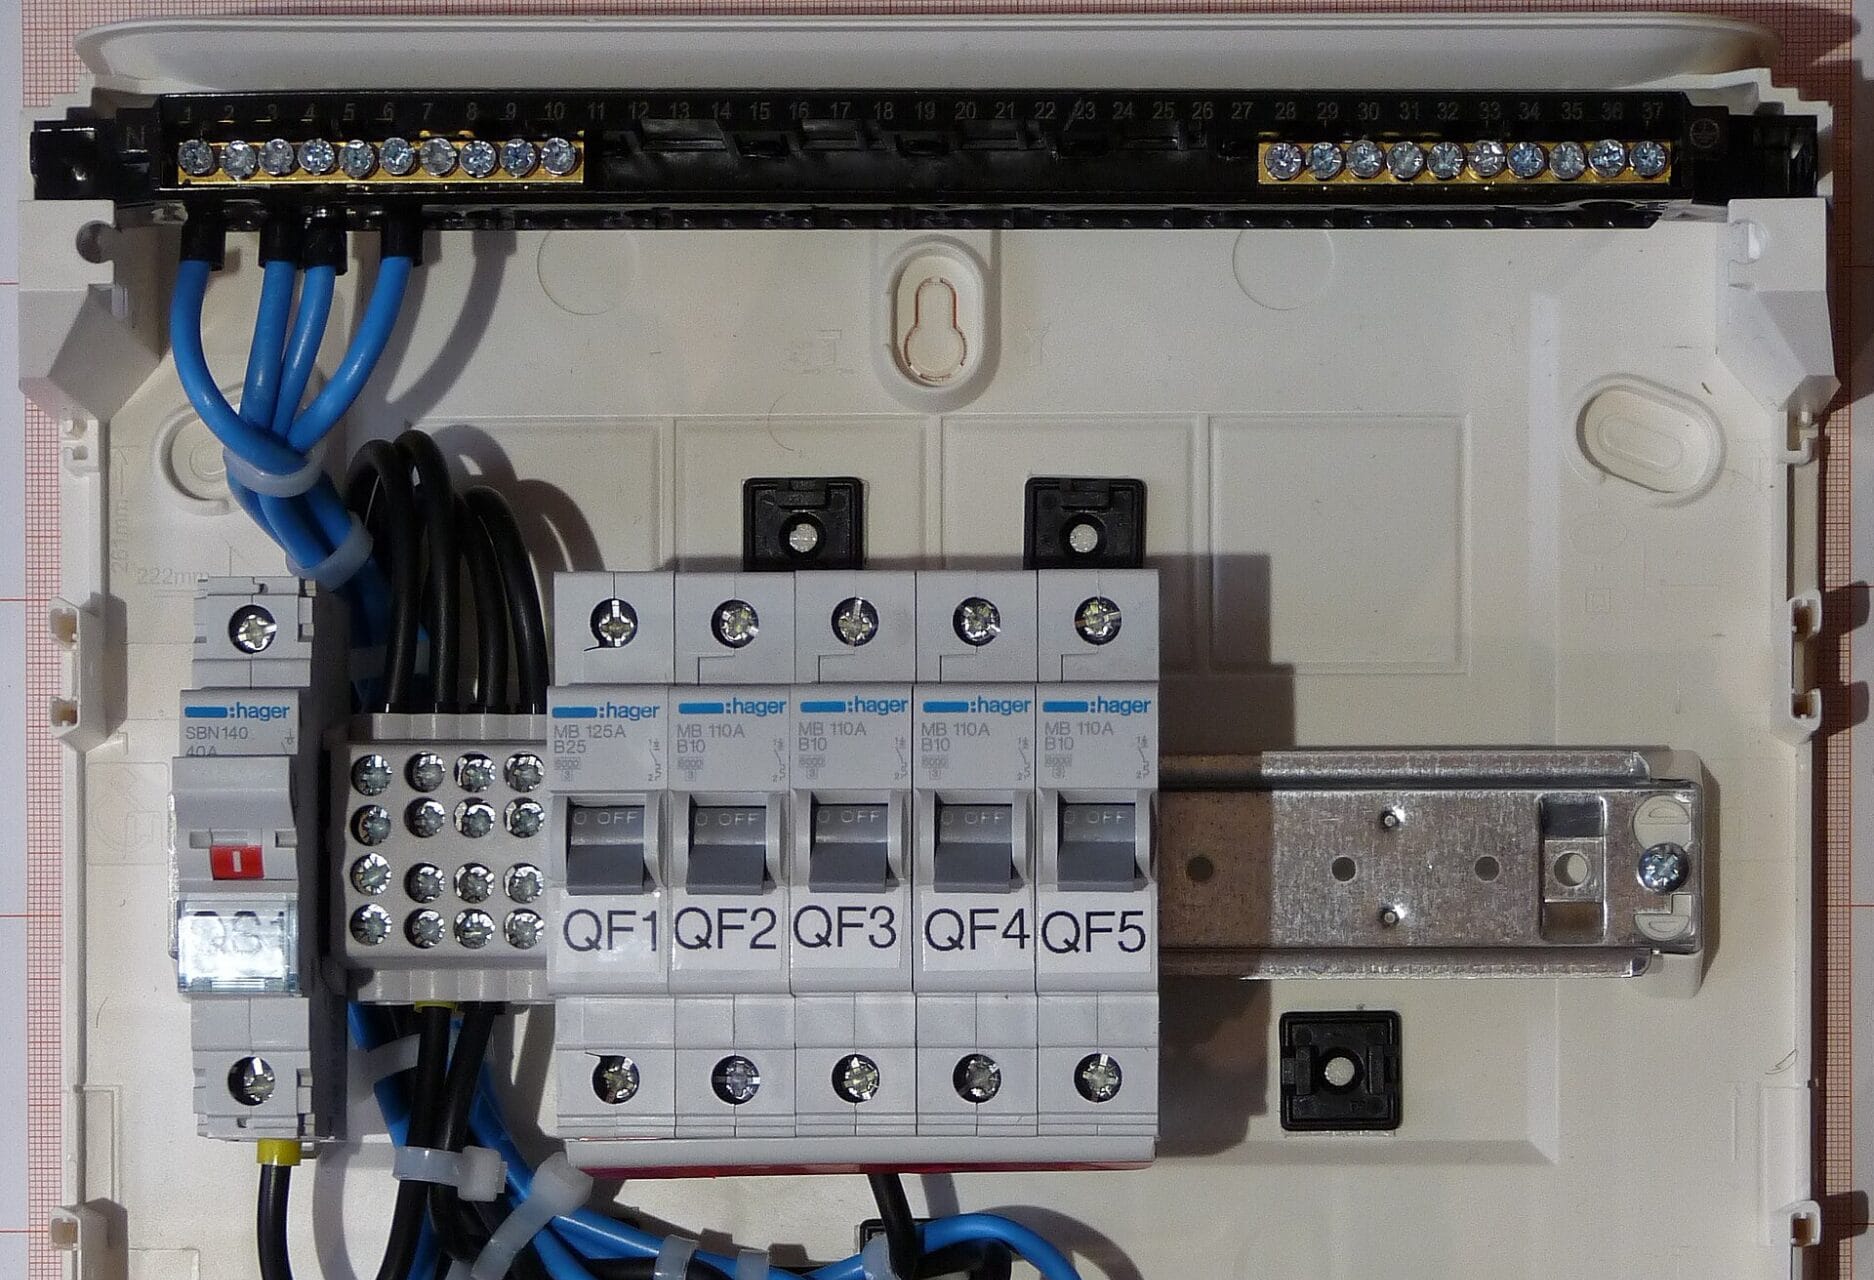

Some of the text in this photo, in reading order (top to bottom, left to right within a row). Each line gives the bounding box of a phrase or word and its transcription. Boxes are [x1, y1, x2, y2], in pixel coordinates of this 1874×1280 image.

[223, 102, 234, 119] 2
[305, 102, 316, 119] 4
[343, 102, 355, 119] 5
[383, 102, 395, 119] 6
[423, 102, 433, 119] 7
[466, 102, 478, 119] 8
[505, 102, 516, 119] 9
[545, 102, 564, 119] 10
[588, 102, 606, 119] 11
[628, 102, 648, 119] 12
[670, 102, 689, 119] 13
[712, 102, 730, 119] 14
[750, 102, 770, 119] 15
[789, 102, 808, 119] 16
[830, 102, 850, 119] 17
[873, 102, 893, 119] 18
[915, 102, 935, 119] 19
[955, 102, 976, 119] 20
[995, 102, 1015, 119] 21
[1034, 102, 1056, 119] 22
[1075, 102, 1095, 119] 23
[1113, 102, 1133, 119] 24
[1153, 102, 1174, 119] 25
[1192, 102, 1214, 119] 26
[1232, 102, 1252, 119] 27
[1275, 102, 1296, 119] 28
[1317, 102, 1338, 119] 29
[1358, 102, 1379, 119] 30
[1400, 102, 1420, 119] 31
[1438, 102, 1458, 119] 32
[1480, 102, 1500, 119] 33
[1520, 102, 1540, 119] 34
[1561, 102, 1582, 119] 35
[1643, 102, 1662, 119] 37
[554, 725, 626, 738] MB 125A
[677, 725, 745, 738] MB 110A
[799, 723, 866, 736] MB 110A
[921, 723, 990, 736] MB 110A
[1045, 722, 1113, 736] MB 110A
[554, 740, 586, 753] B25
[677, 740, 705, 753] B10
[799, 738, 827, 751] B10
[922, 738, 950, 751] B10
[1045, 738, 1073, 751] B10
[598, 812, 638, 824] OFF
[719, 813, 762, 825] OFF
[841, 810, 880, 823] OFF
[965, 811, 1004, 824] OFF
[1088, 810, 1129, 824] OFF
[563, 909, 657, 951] QF1
[675, 907, 777, 950] QF2
[793, 905, 896, 948] QF3
[925, 908, 1030, 952] QF4
[1041, 910, 1146, 953] QF5
